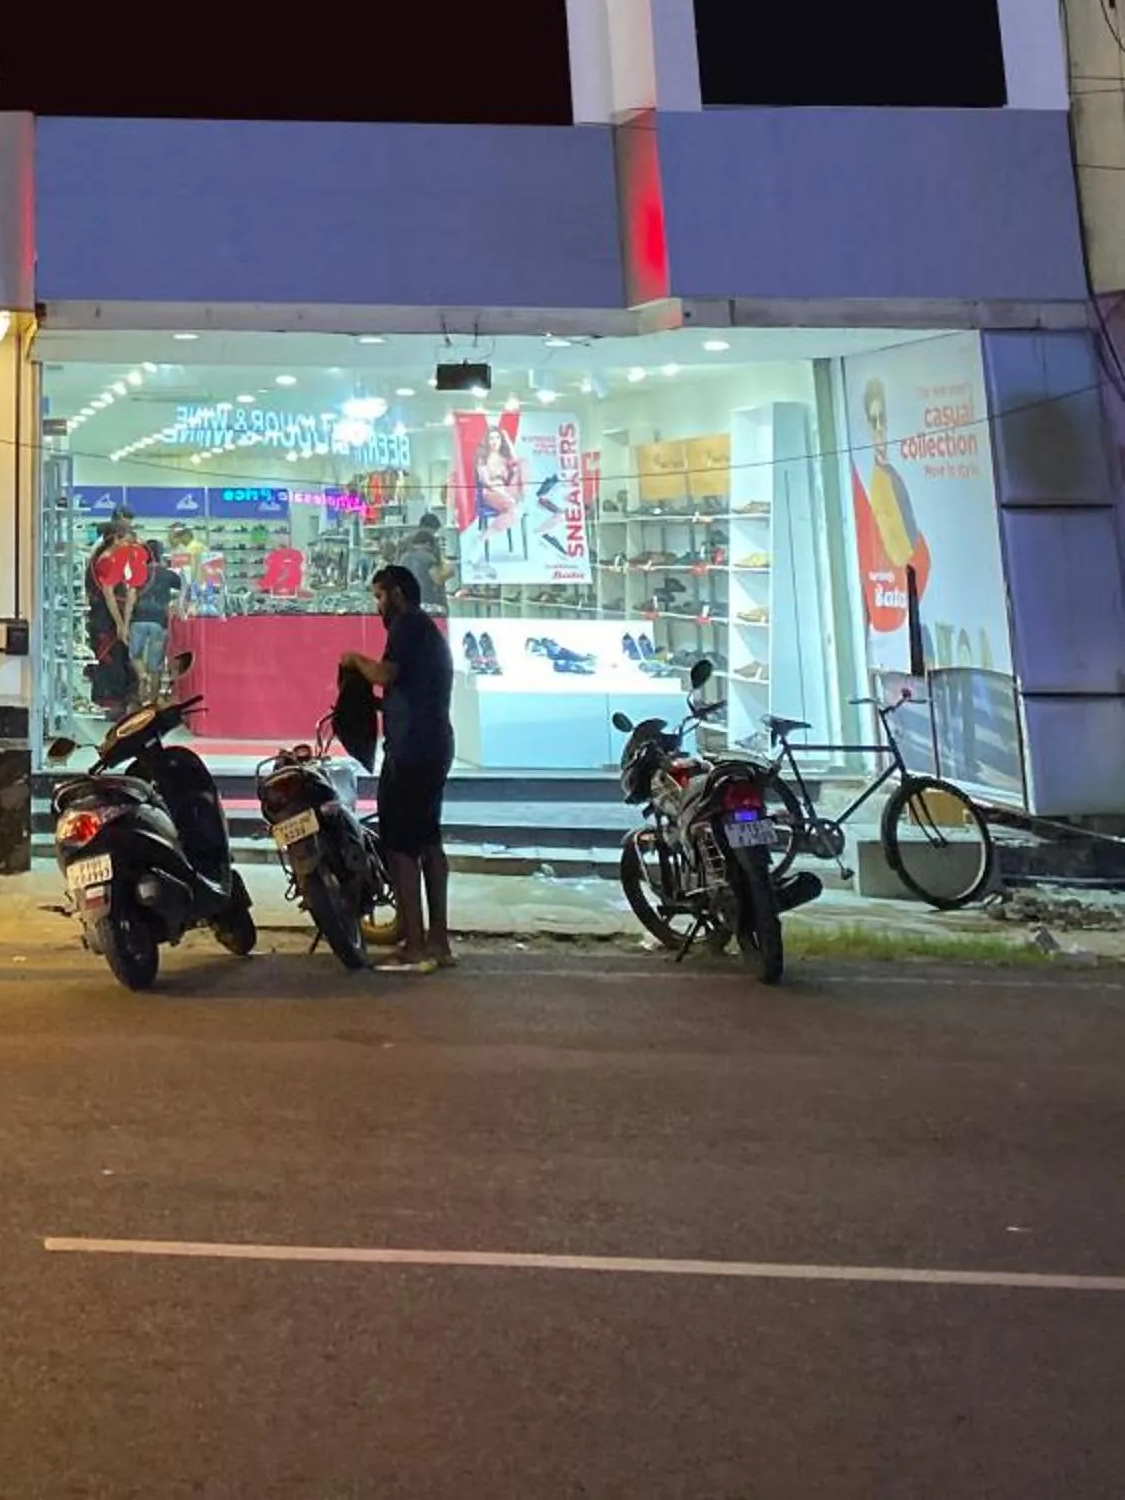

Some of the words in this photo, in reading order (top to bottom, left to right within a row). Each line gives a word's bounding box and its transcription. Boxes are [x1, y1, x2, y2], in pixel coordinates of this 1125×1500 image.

[924, 396, 974, 428] casual
[900, 431, 978, 460] collection
[558, 422, 585, 558] SNEAKERS
